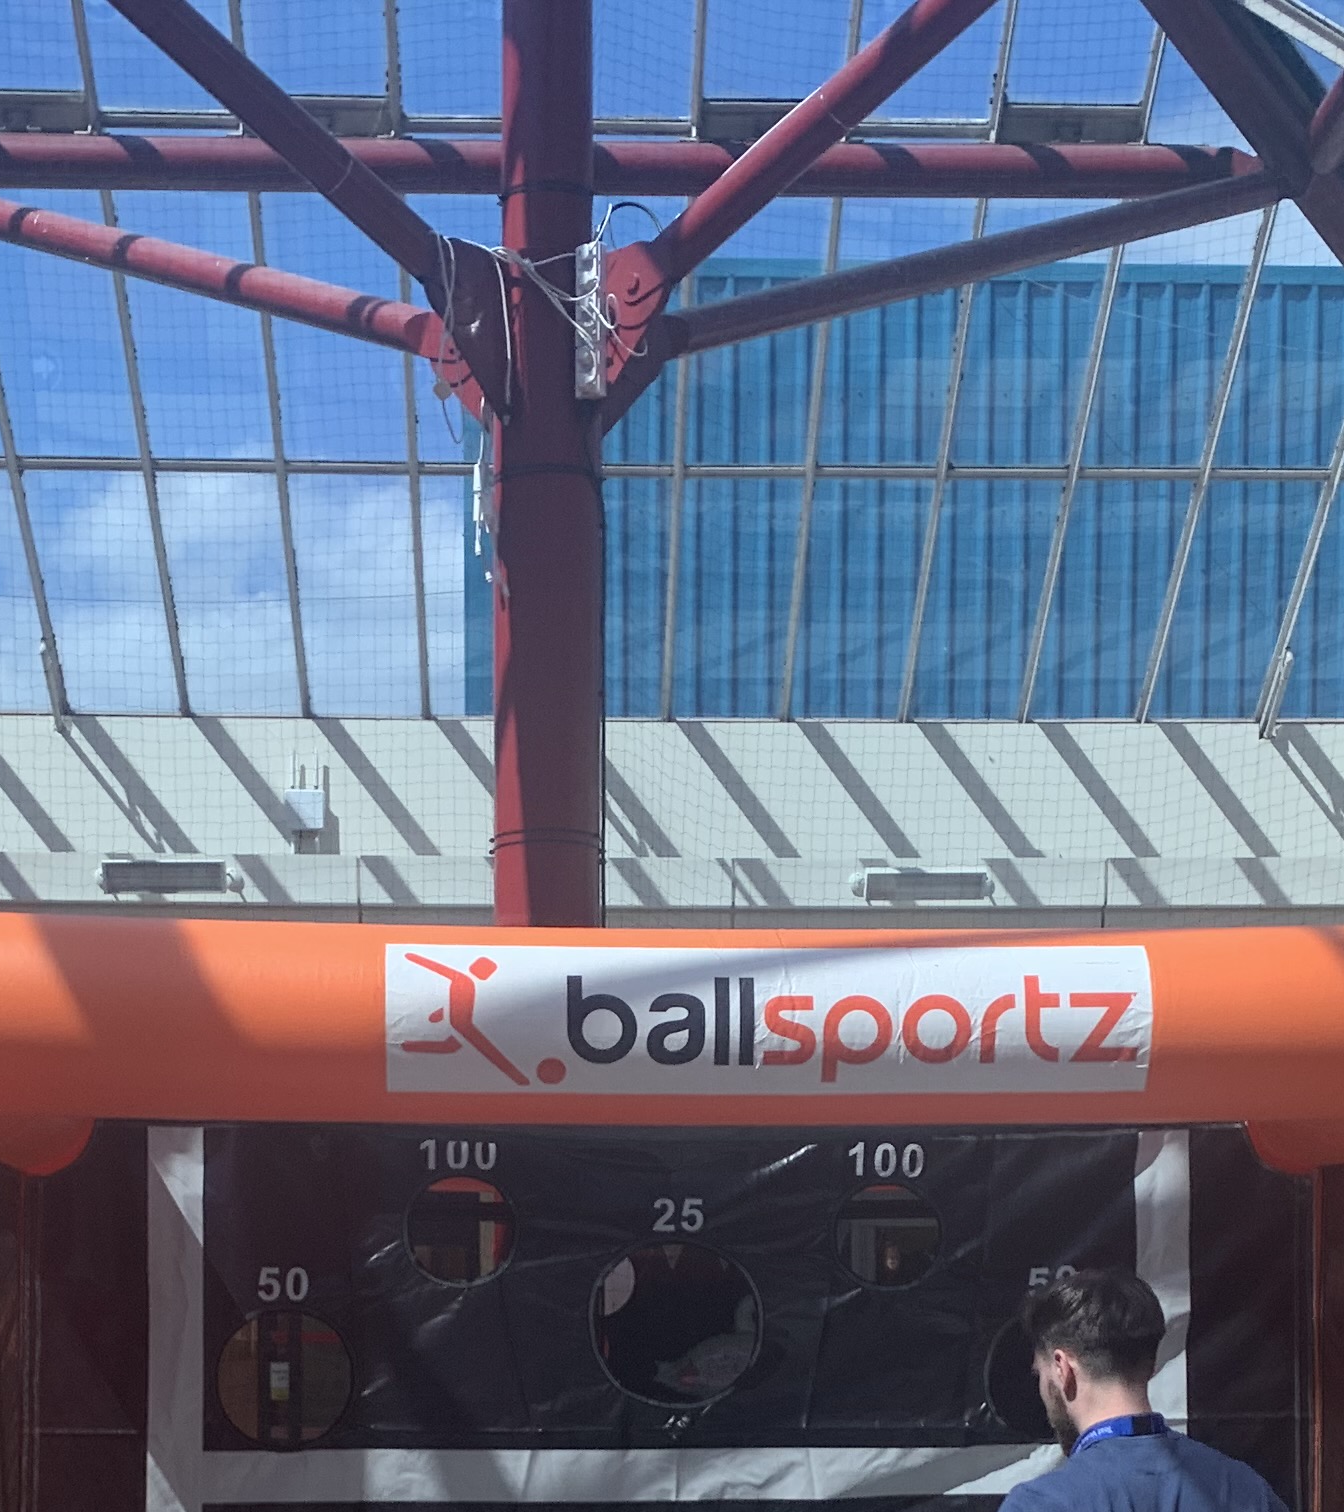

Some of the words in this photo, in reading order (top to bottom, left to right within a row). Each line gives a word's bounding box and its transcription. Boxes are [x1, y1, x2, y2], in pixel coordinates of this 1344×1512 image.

[566, 974, 1138, 1083] ballsportz
[419, 1138, 498, 1171] 100
[848, 1141, 925, 1178] 100
[652, 1197, 704, 1233] 25
[257, 1266, 309, 1301] 50
